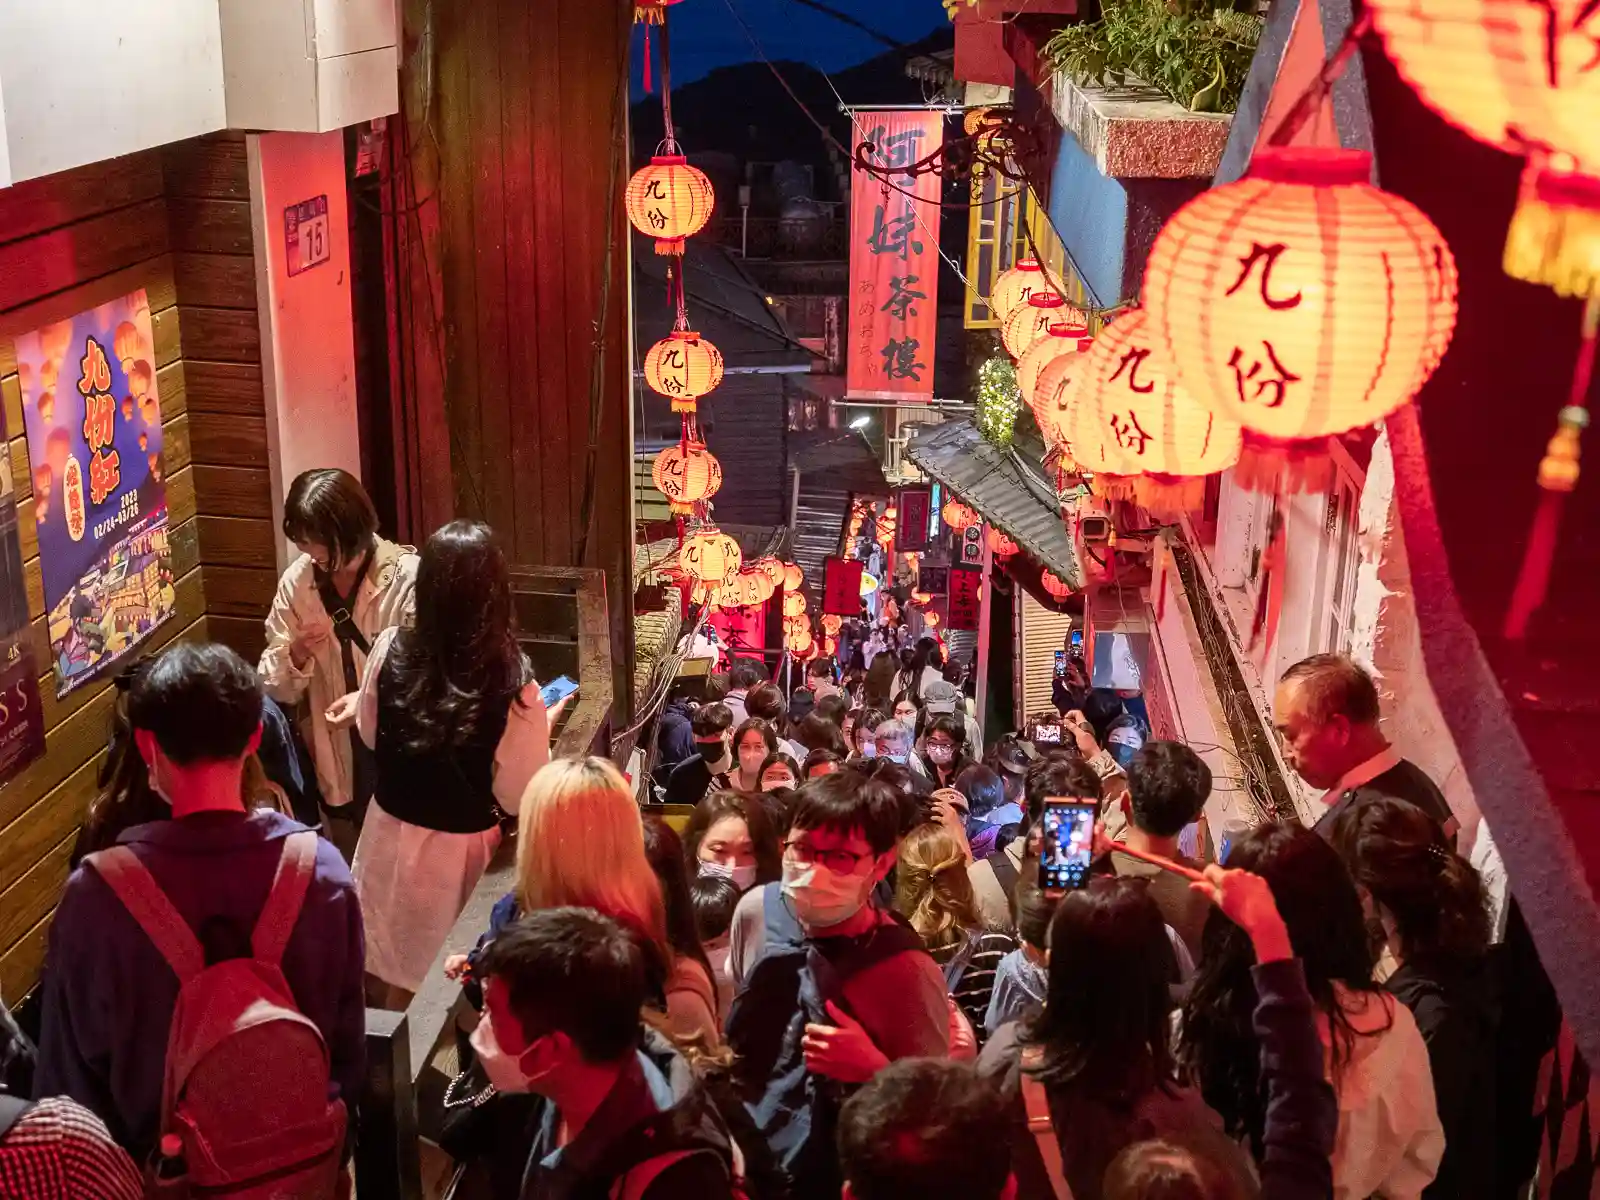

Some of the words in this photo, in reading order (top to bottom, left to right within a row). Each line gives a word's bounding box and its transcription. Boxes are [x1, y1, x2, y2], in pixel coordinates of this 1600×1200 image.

[645, 180, 669, 229] 九份
[306, 221, 323, 261] 15
[865, 125, 927, 382] 阿妹茶樓
[1225, 241, 1303, 408] 九份
[663, 349, 686, 394] 九份
[79, 337, 121, 505] 九份紅
[1110, 346, 1154, 455] 九份
[120, 488, 138, 509] 2023
[663, 459, 682, 497] 九份
[93, 502, 139, 540] 02/24-03/26
[7, 642, 20, 660] 4K
